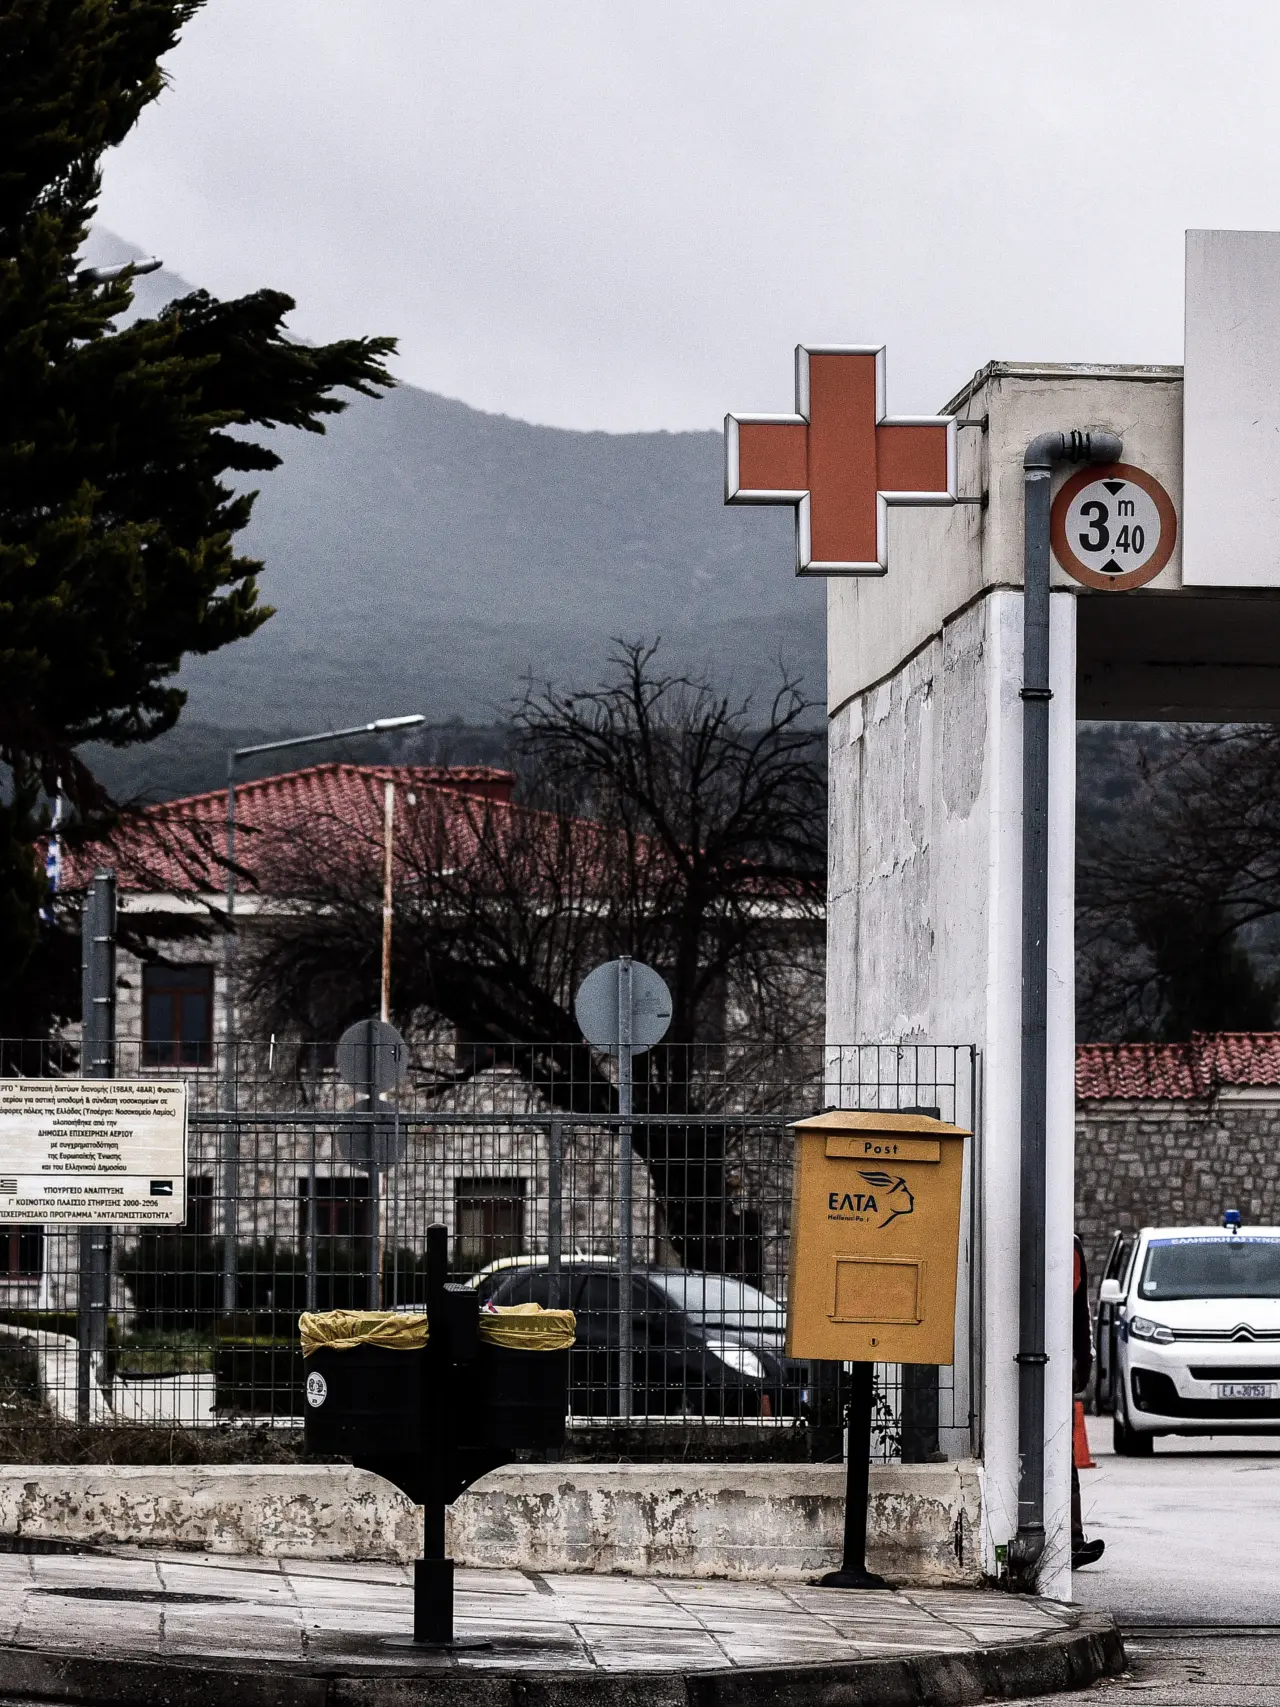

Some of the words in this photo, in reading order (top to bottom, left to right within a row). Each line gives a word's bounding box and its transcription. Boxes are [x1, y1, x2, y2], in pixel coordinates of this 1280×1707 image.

[864, 1142, 898, 1155] Post
[43, 1187, 83, 1195] ΥΠΟΥΡΓΕΙΟ
[84, 1187, 124, 1195] ΑΝΑΠΤΥΞΗΣ
[57, 1199, 86, 1207] ΠΛΑΙΣΙΟ
[88, 1199, 121, 1207] ΣΤΗΡΙΞΗΣ
[828, 1192, 878, 1213] ΕΛΤΑ
[50, 1211, 92, 1219] ΠΡΟΓΡΑΜΜΑ
